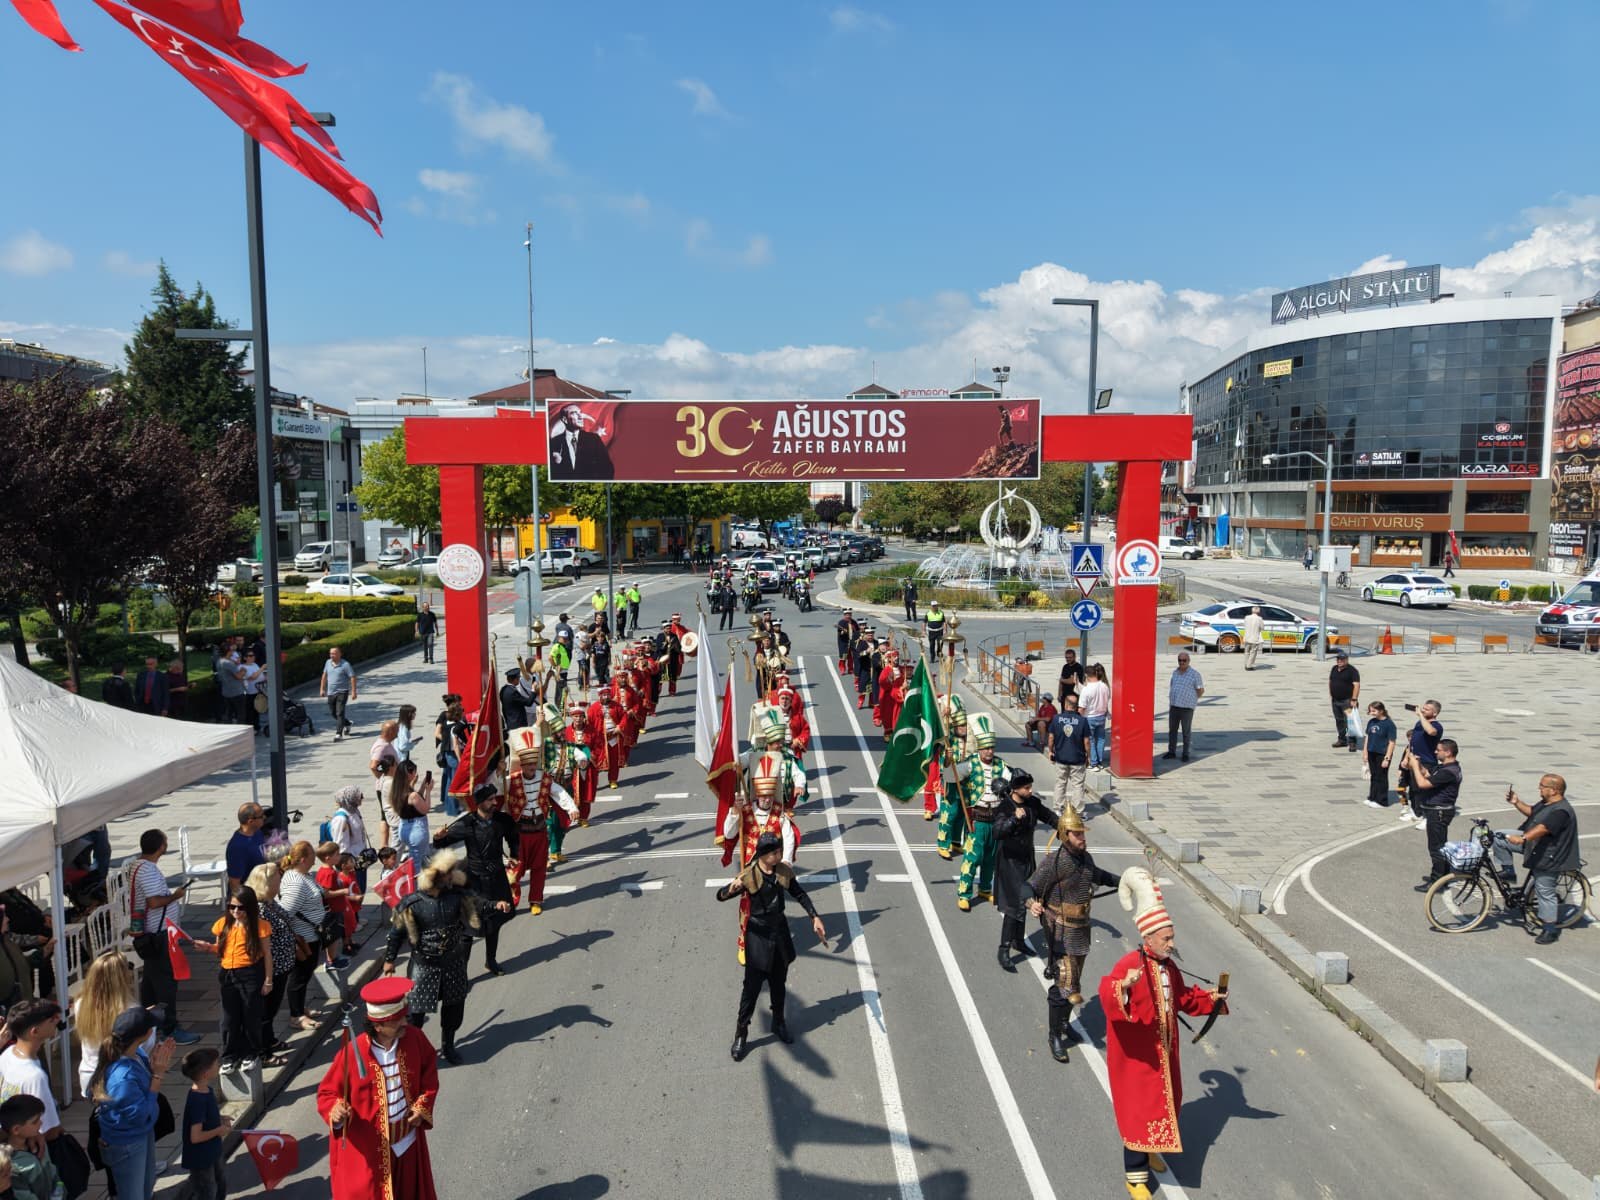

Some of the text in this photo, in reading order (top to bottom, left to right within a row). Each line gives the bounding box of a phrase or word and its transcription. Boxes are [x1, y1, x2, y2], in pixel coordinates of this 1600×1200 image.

[1362, 272, 1430, 299] STATÜ
[773, 404, 906, 438] AĞUSTOS
[773, 440, 906, 454] ZAFER BAYRAMI
[1372, 452, 1402, 460] SATILIK
[743, 459, 838, 477] Kutlu Olsun
[1372, 517, 1424, 531] VURUŞ
